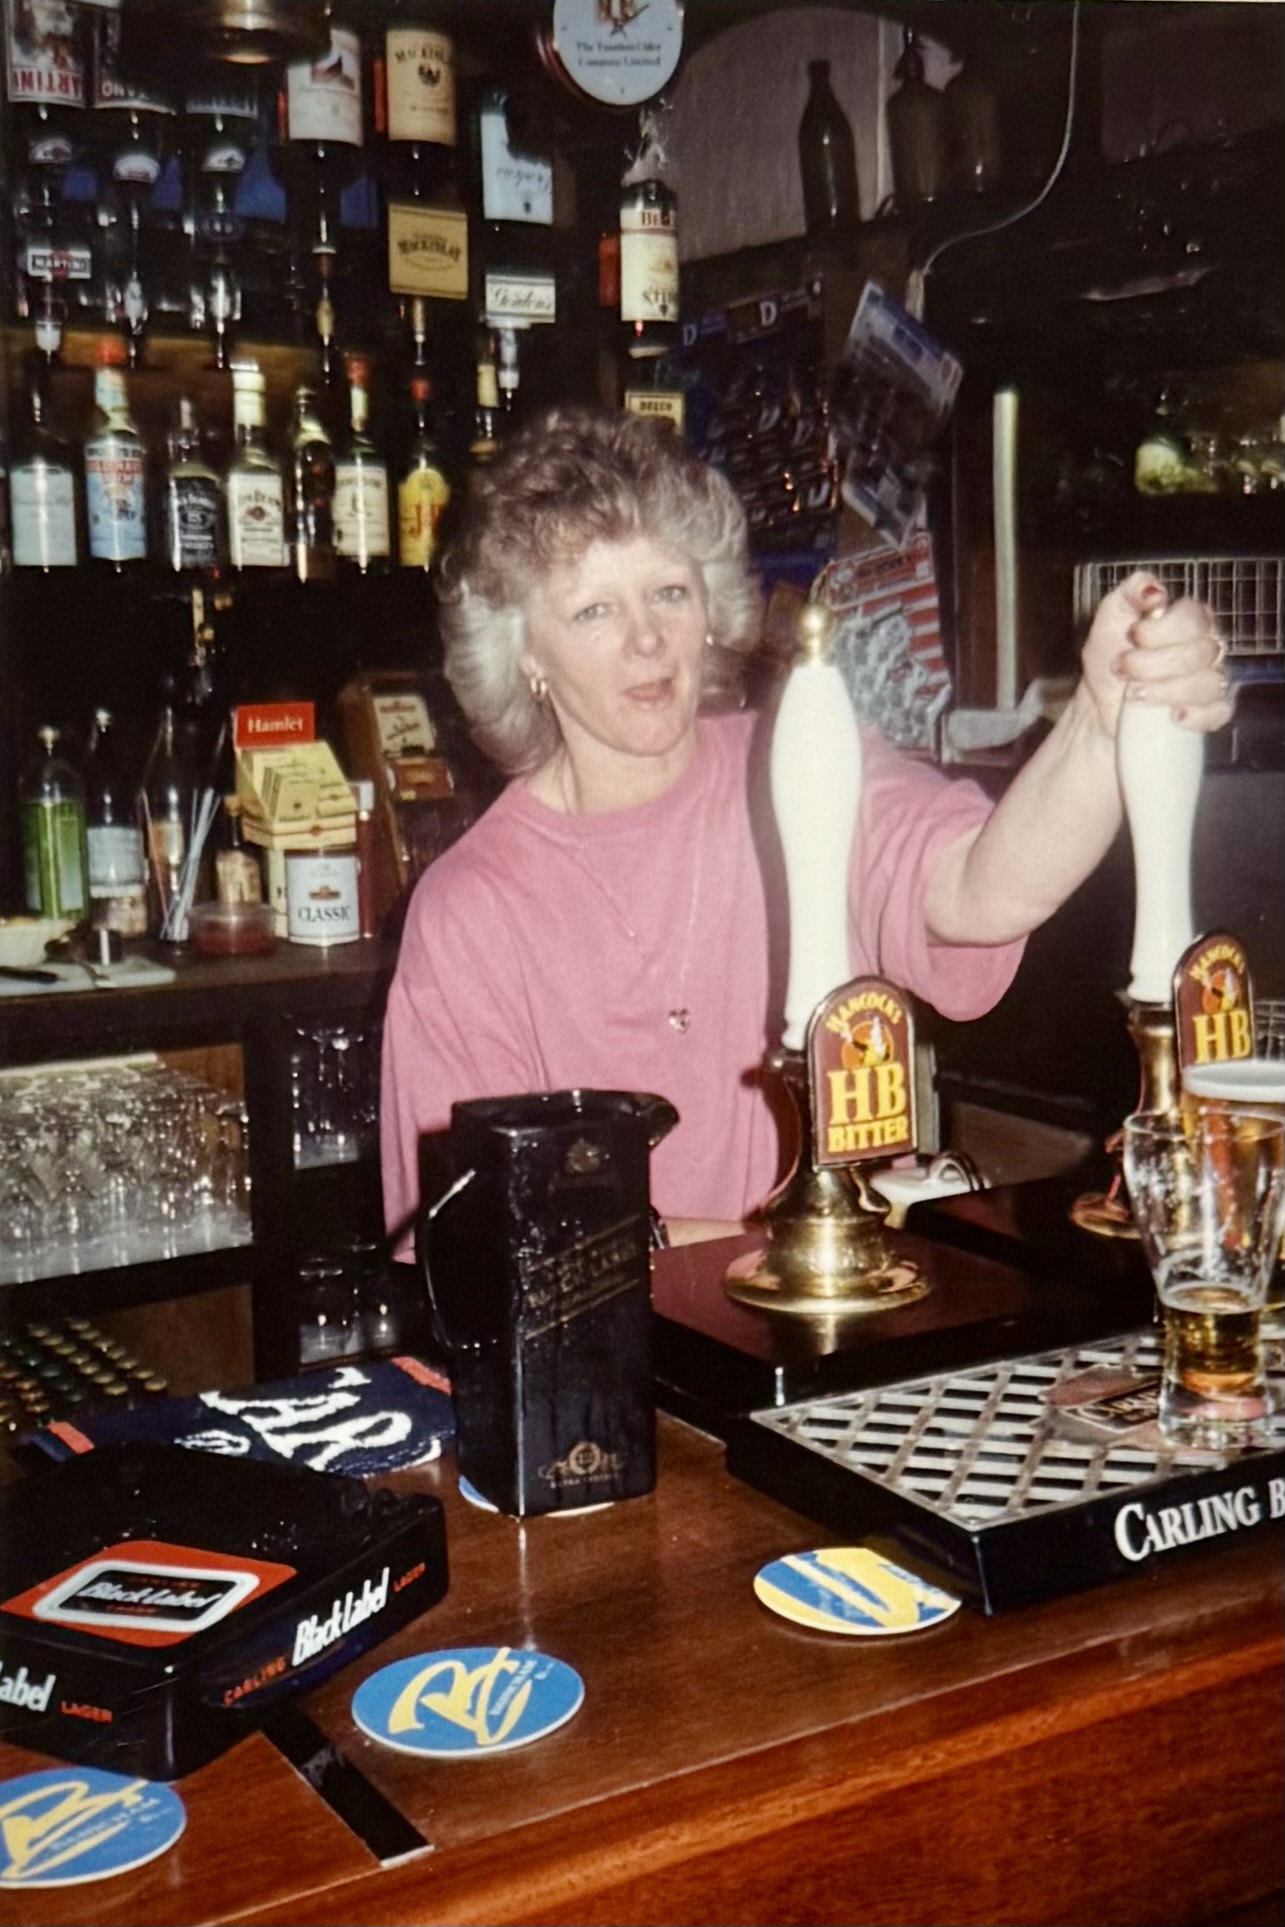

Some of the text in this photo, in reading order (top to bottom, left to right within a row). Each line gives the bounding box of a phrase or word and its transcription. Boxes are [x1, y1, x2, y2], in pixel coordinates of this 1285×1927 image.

[248, 716, 303, 733] Hamlet
[298, 905, 351, 922] CLASSIC
[1192, 1010, 1250, 1064] HB
[827, 1062, 907, 1126] HB
[828, 1115, 909, 1153] BITTER
[1114, 1486, 1261, 1562] CARLING
[77, 1581, 224, 1609] Black Label
[291, 1600, 342, 1667] Black
[342, 1567, 390, 1633] Label
[0, 1661, 56, 1712] abel
